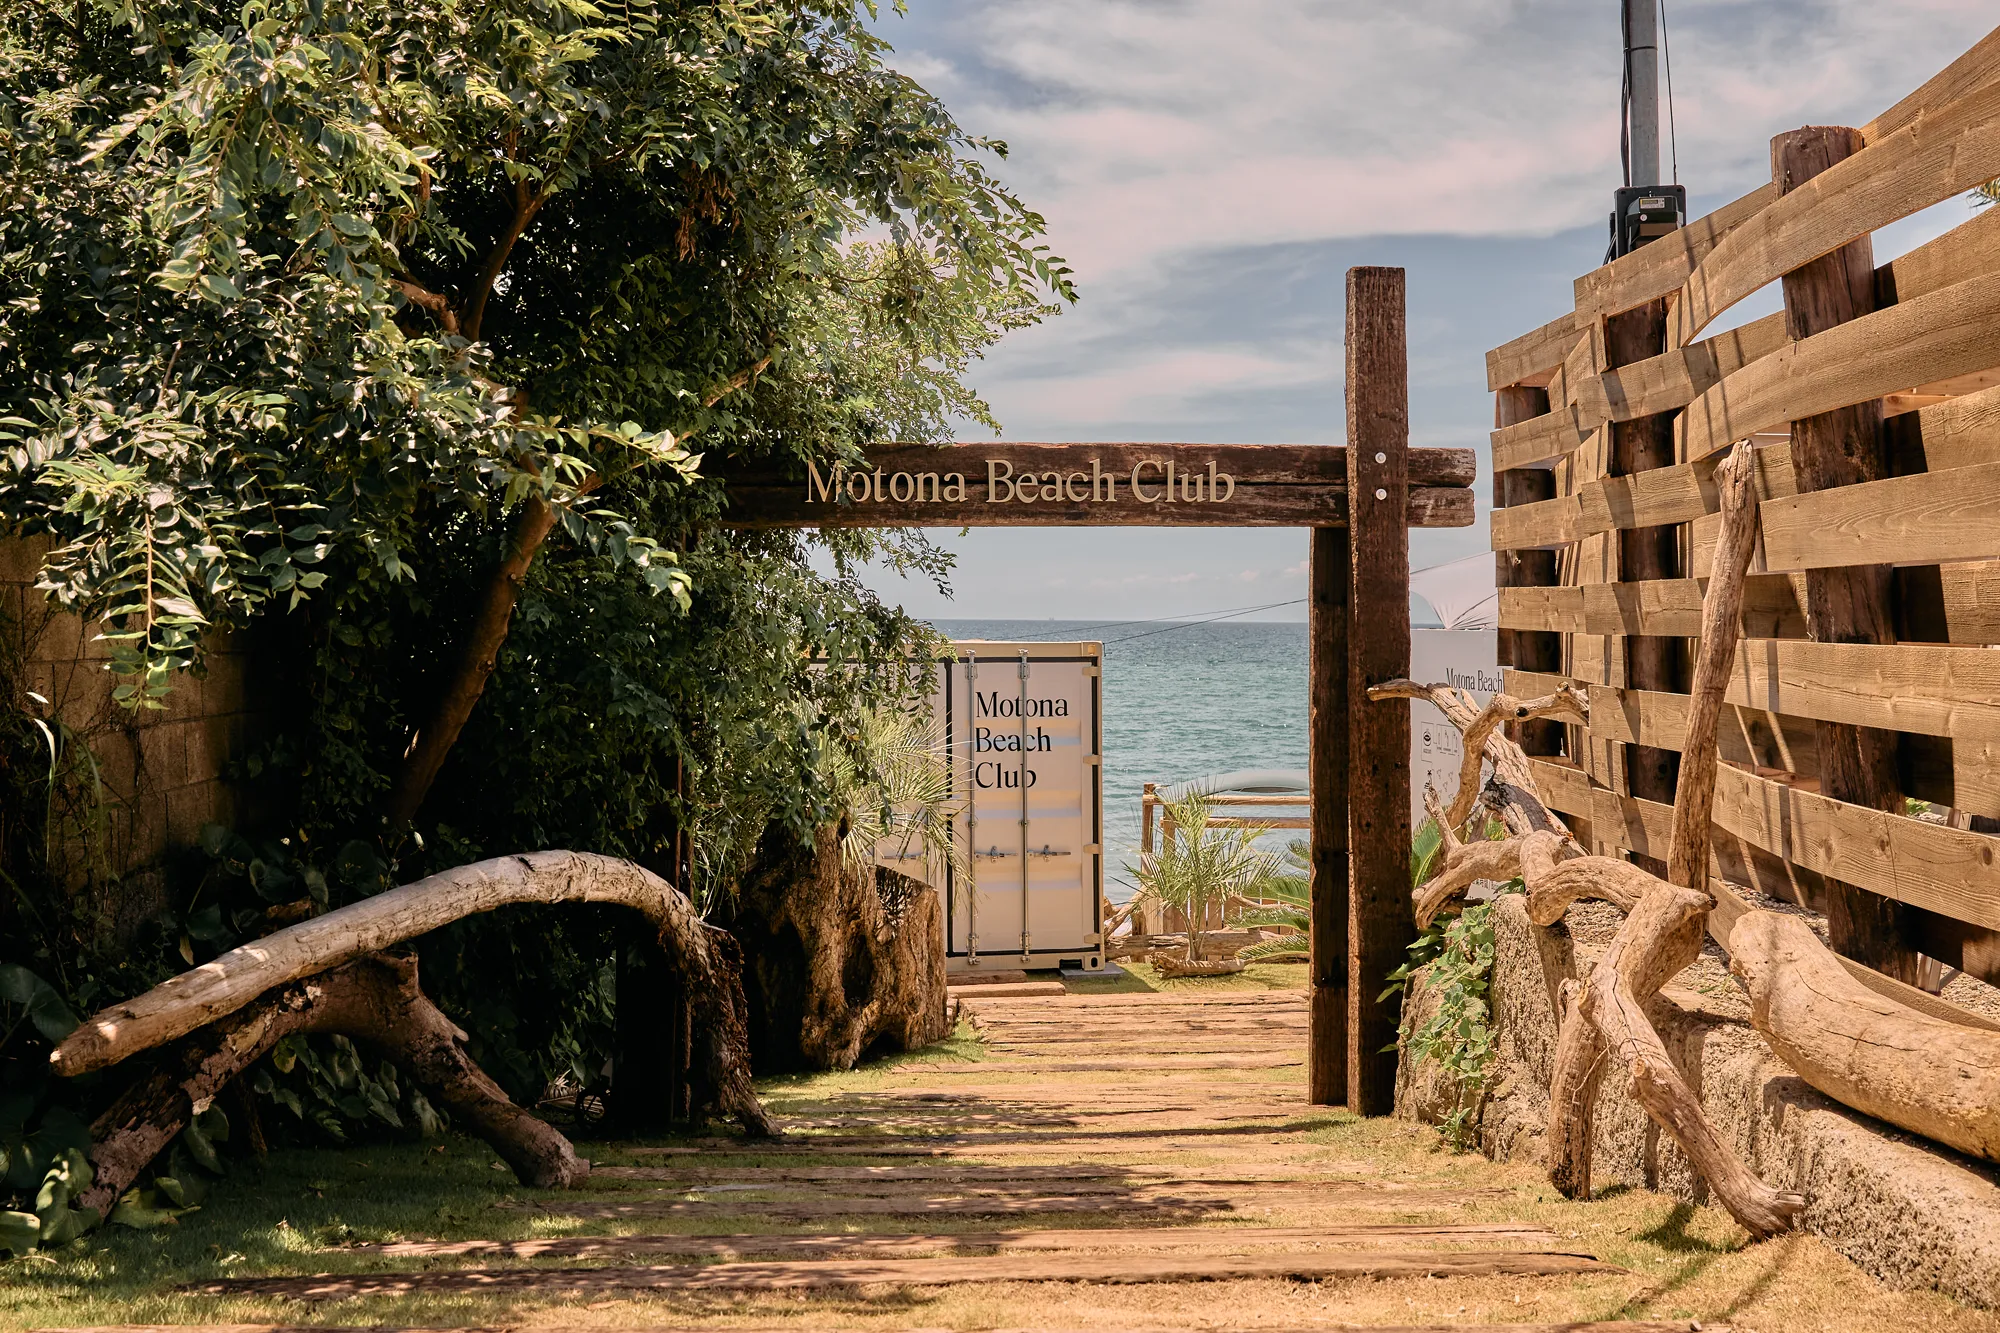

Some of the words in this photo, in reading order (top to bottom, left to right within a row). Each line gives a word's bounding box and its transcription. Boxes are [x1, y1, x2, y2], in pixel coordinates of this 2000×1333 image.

[804, 459, 968, 503] Motona
[984, 458, 1117, 504] Beach
[1131, 459, 1235, 504] Club
[1477, 670, 1503, 693] Beach
[975, 691, 1069, 718] Motona
[975, 726, 1052, 752] Beach
[975, 761, 1037, 788] Club
